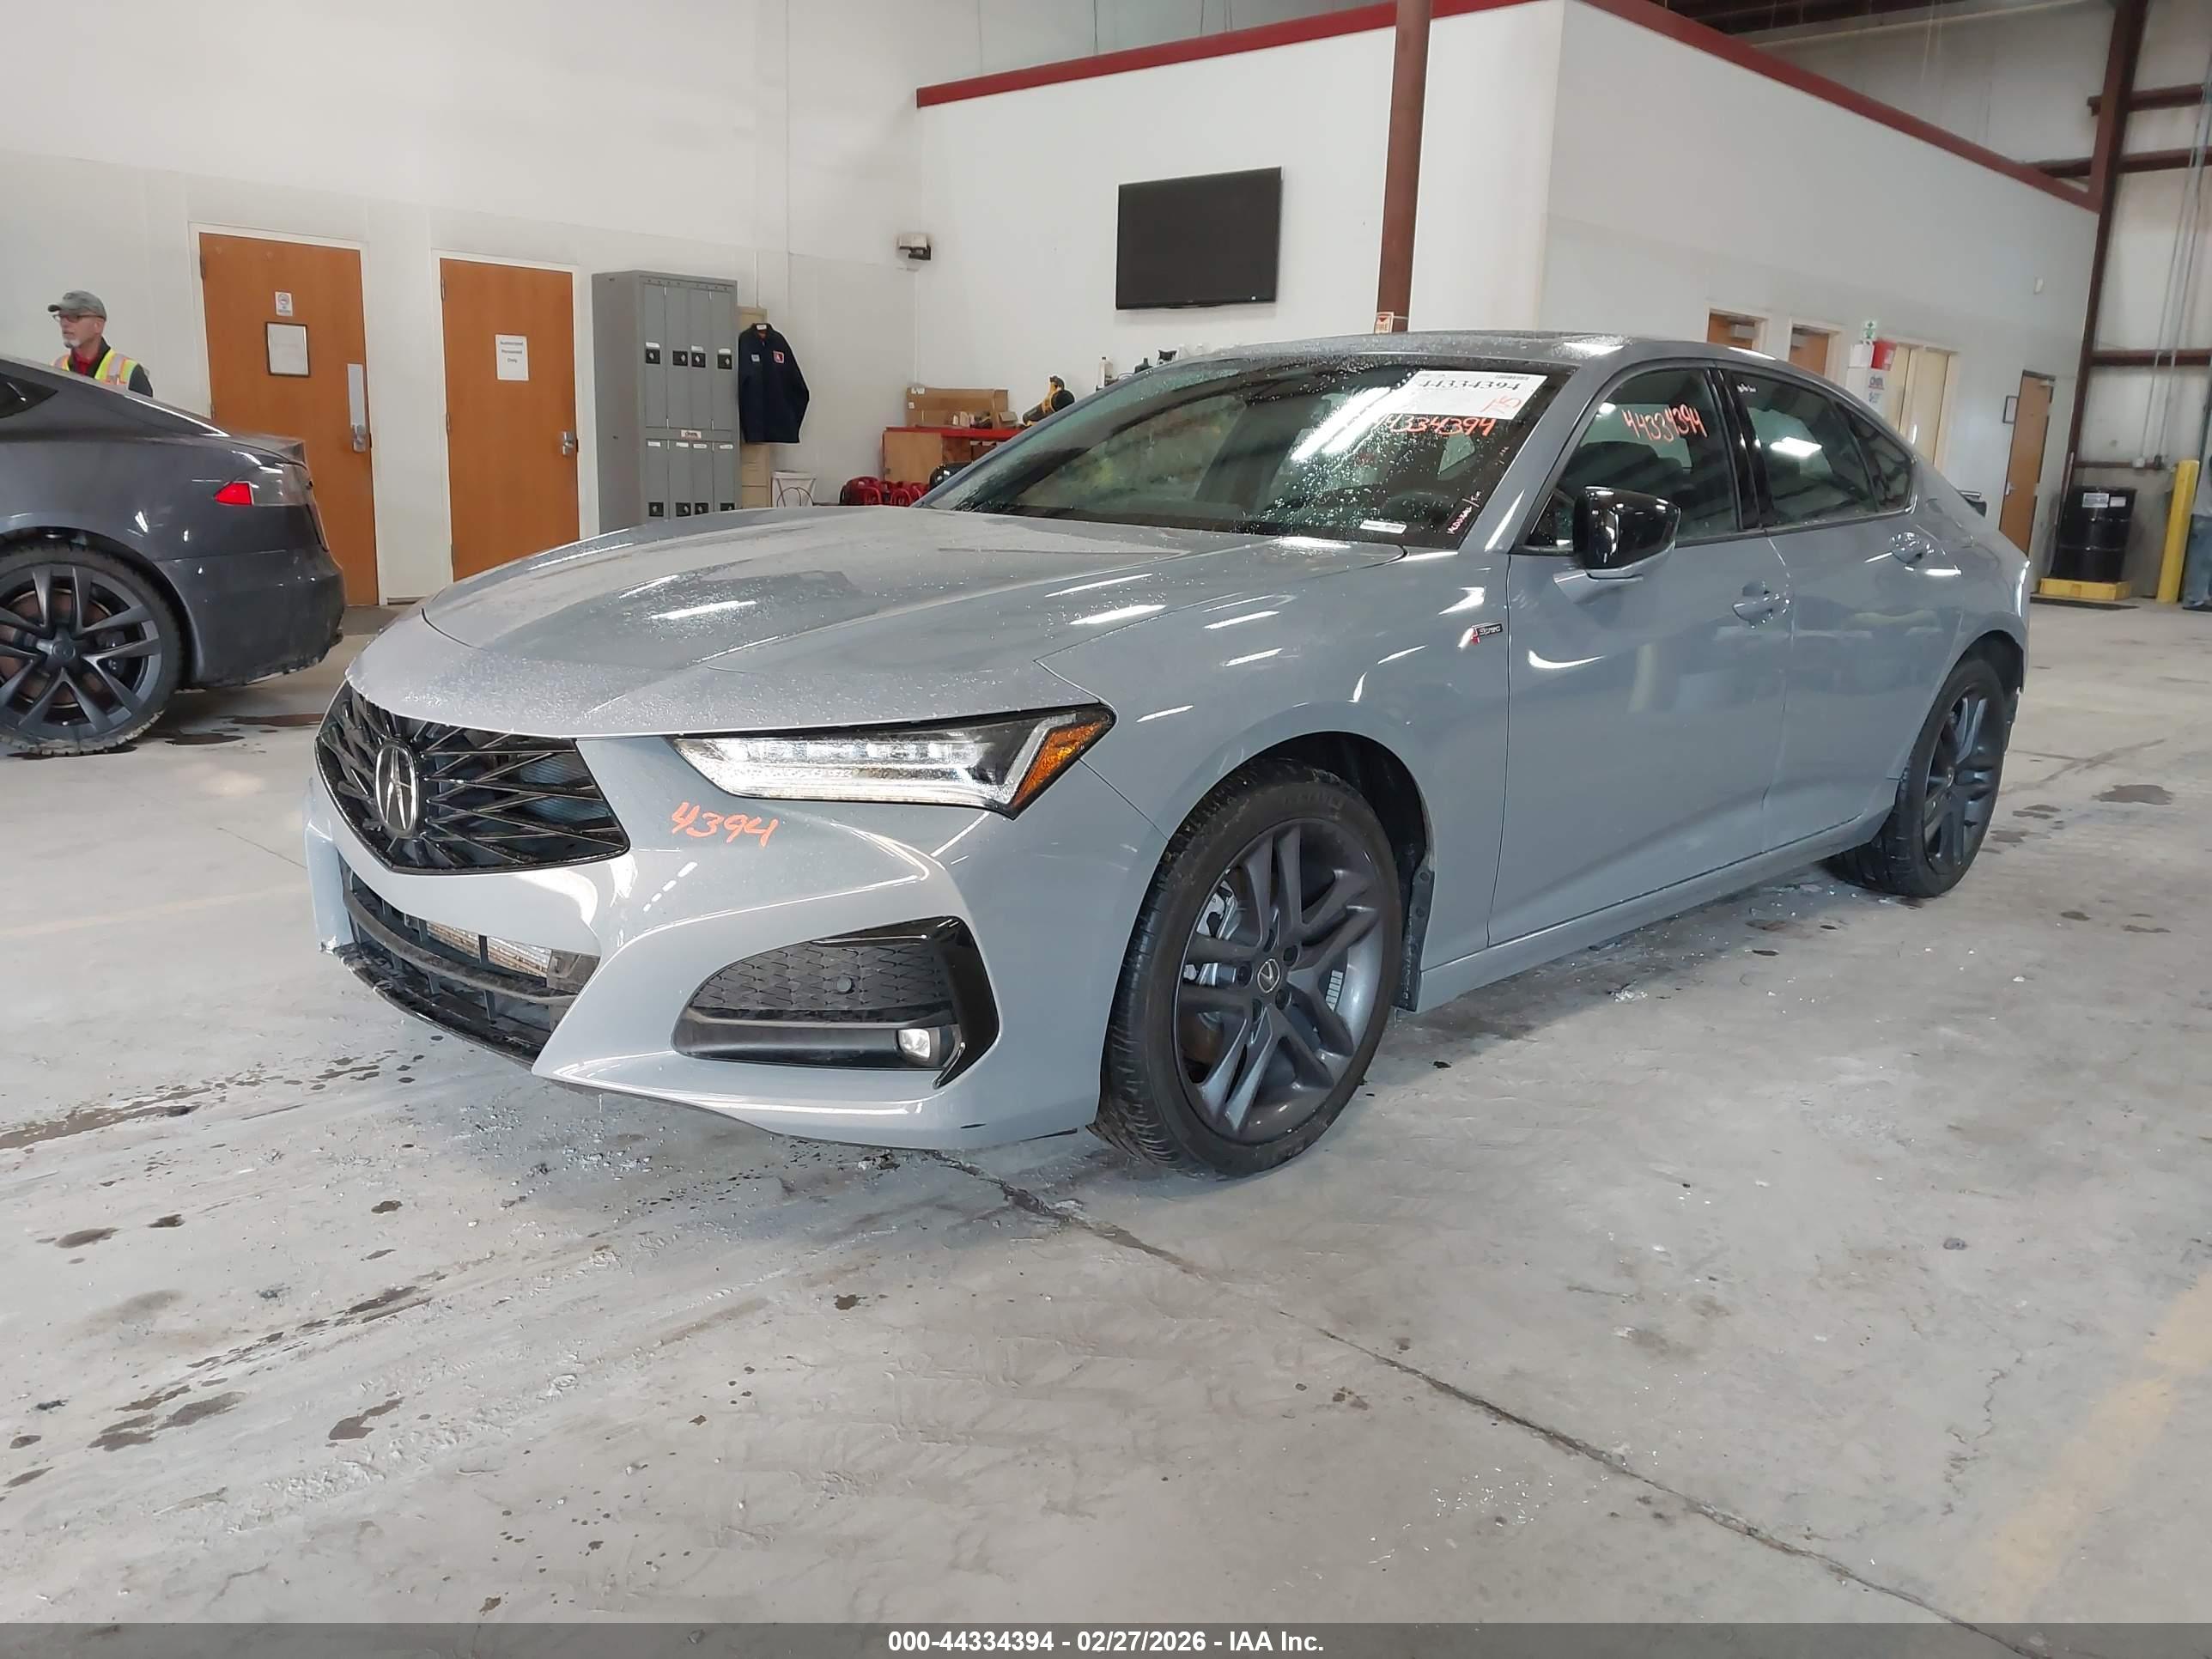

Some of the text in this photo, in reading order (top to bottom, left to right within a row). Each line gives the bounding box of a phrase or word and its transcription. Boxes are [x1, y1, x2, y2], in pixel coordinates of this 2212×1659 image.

[1419, 379, 1522, 391] 44334394
[1621, 404, 1709, 442] 44334394
[672, 801, 779, 848] 4394
